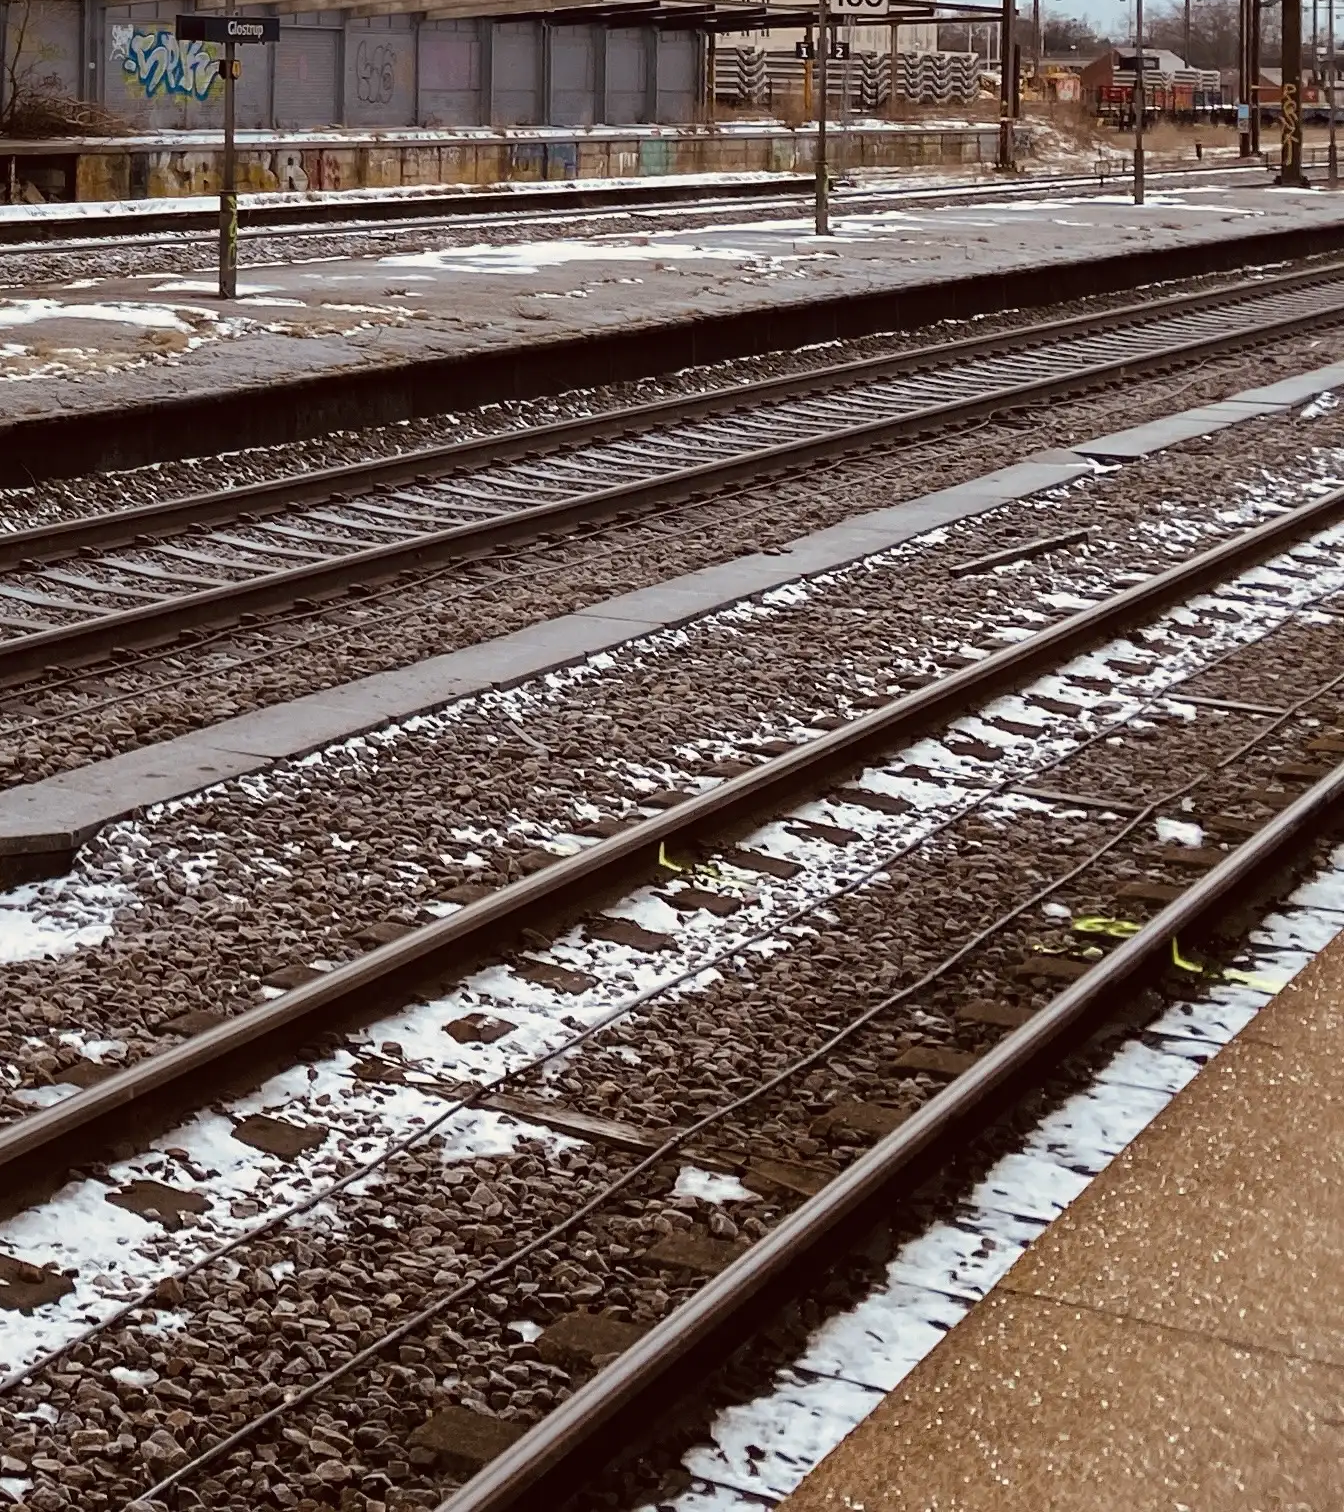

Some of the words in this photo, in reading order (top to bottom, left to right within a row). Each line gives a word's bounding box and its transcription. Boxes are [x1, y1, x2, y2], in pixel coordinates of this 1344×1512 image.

[227, 20, 264, 38] Glostrup
[800, 47, 809, 58] 1
[835, 47, 844, 58] 2
